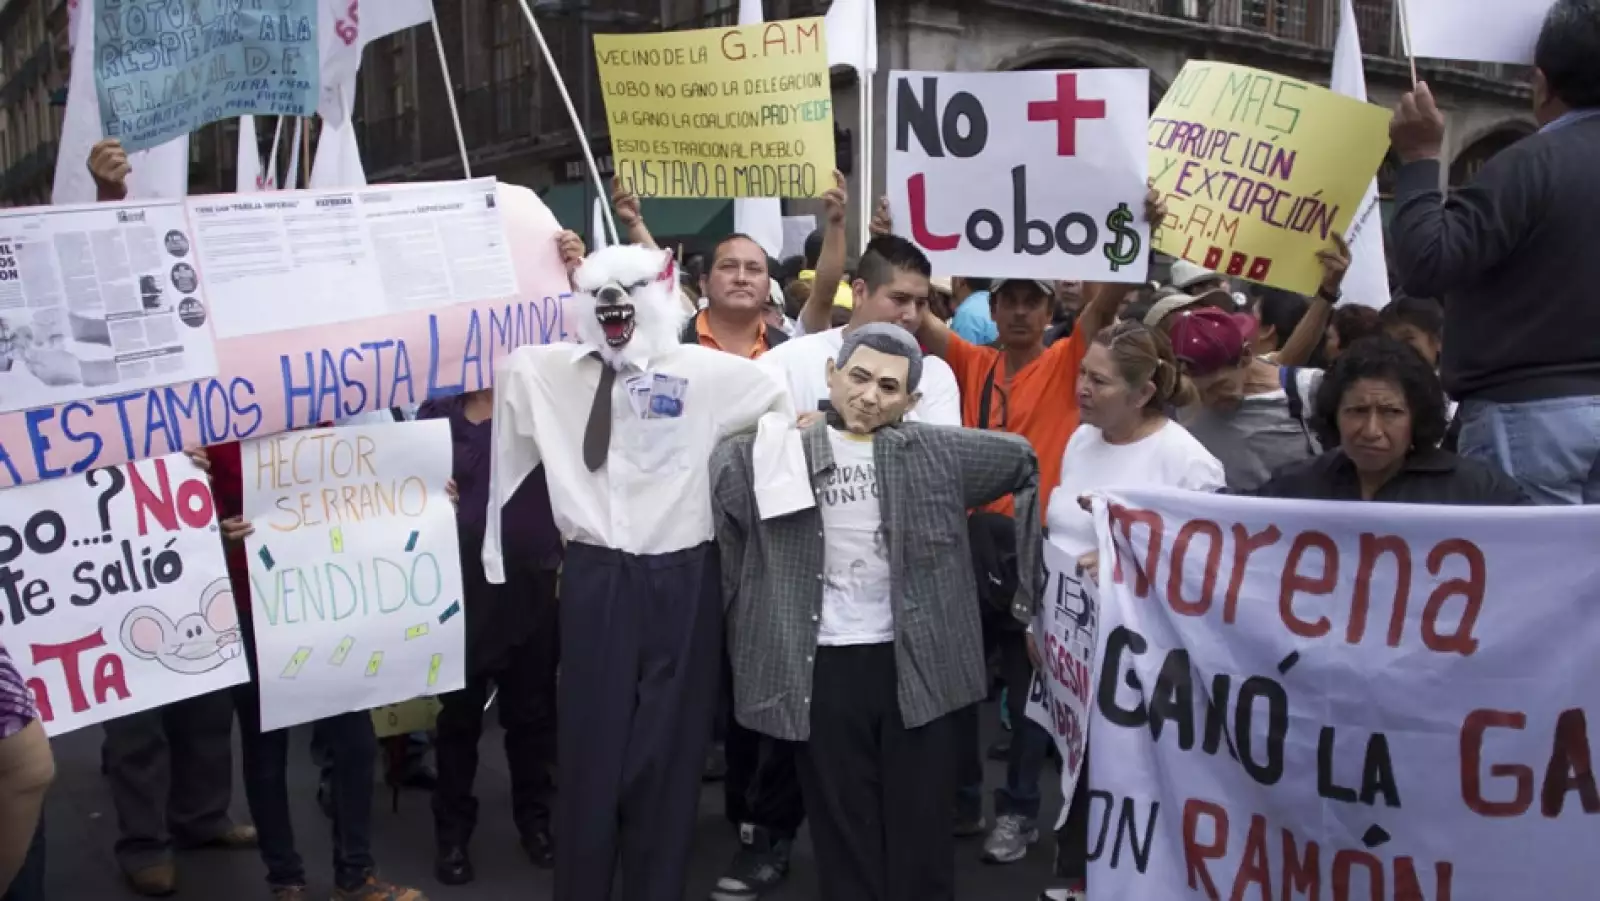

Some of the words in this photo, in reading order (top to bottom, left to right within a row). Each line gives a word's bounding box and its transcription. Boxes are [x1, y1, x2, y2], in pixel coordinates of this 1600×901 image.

[599, 48, 660, 67] VECINO
[664, 47, 686, 66] DE
[689, 46, 708, 64] LA
[606, 81, 650, 98] LOBO
[655, 83, 676, 99] NO
[681, 81, 718, 98] GANO
[722, 80, 739, 97] LA
[744, 72, 823, 97] DELEGACION
[612, 110, 630, 126] LA
[633, 111, 670, 127] GANO
[671, 111, 691, 129] LA
[692, 110, 760, 130] COALICION
[1210, 70, 1309, 135] MAS
[616, 138, 650, 154] ESTO
[652, 140, 670, 156] ES
[671, 141, 729, 159] TRAICION
[730, 143, 749, 160] AL
[750, 138, 806, 159] PUEBLO
[618, 158, 709, 198] GUSTAVO
[715, 163, 729, 197] A
[733, 161, 817, 198] MADERO
[1147, 117, 1298, 182] CORRUPCIÓN
[1174, 160, 1340, 241] EXTORCIÓN
[1180, 235, 1273, 282] LOBO
[25, 376, 263, 480] ESTAMOS
[280, 338, 416, 431] HASTA
[255, 432, 377, 491] HECTOR
[268, 475, 428, 532] SERRANO
[250, 551, 443, 627] VENDIDO
[1316, 725, 1402, 808] LA
